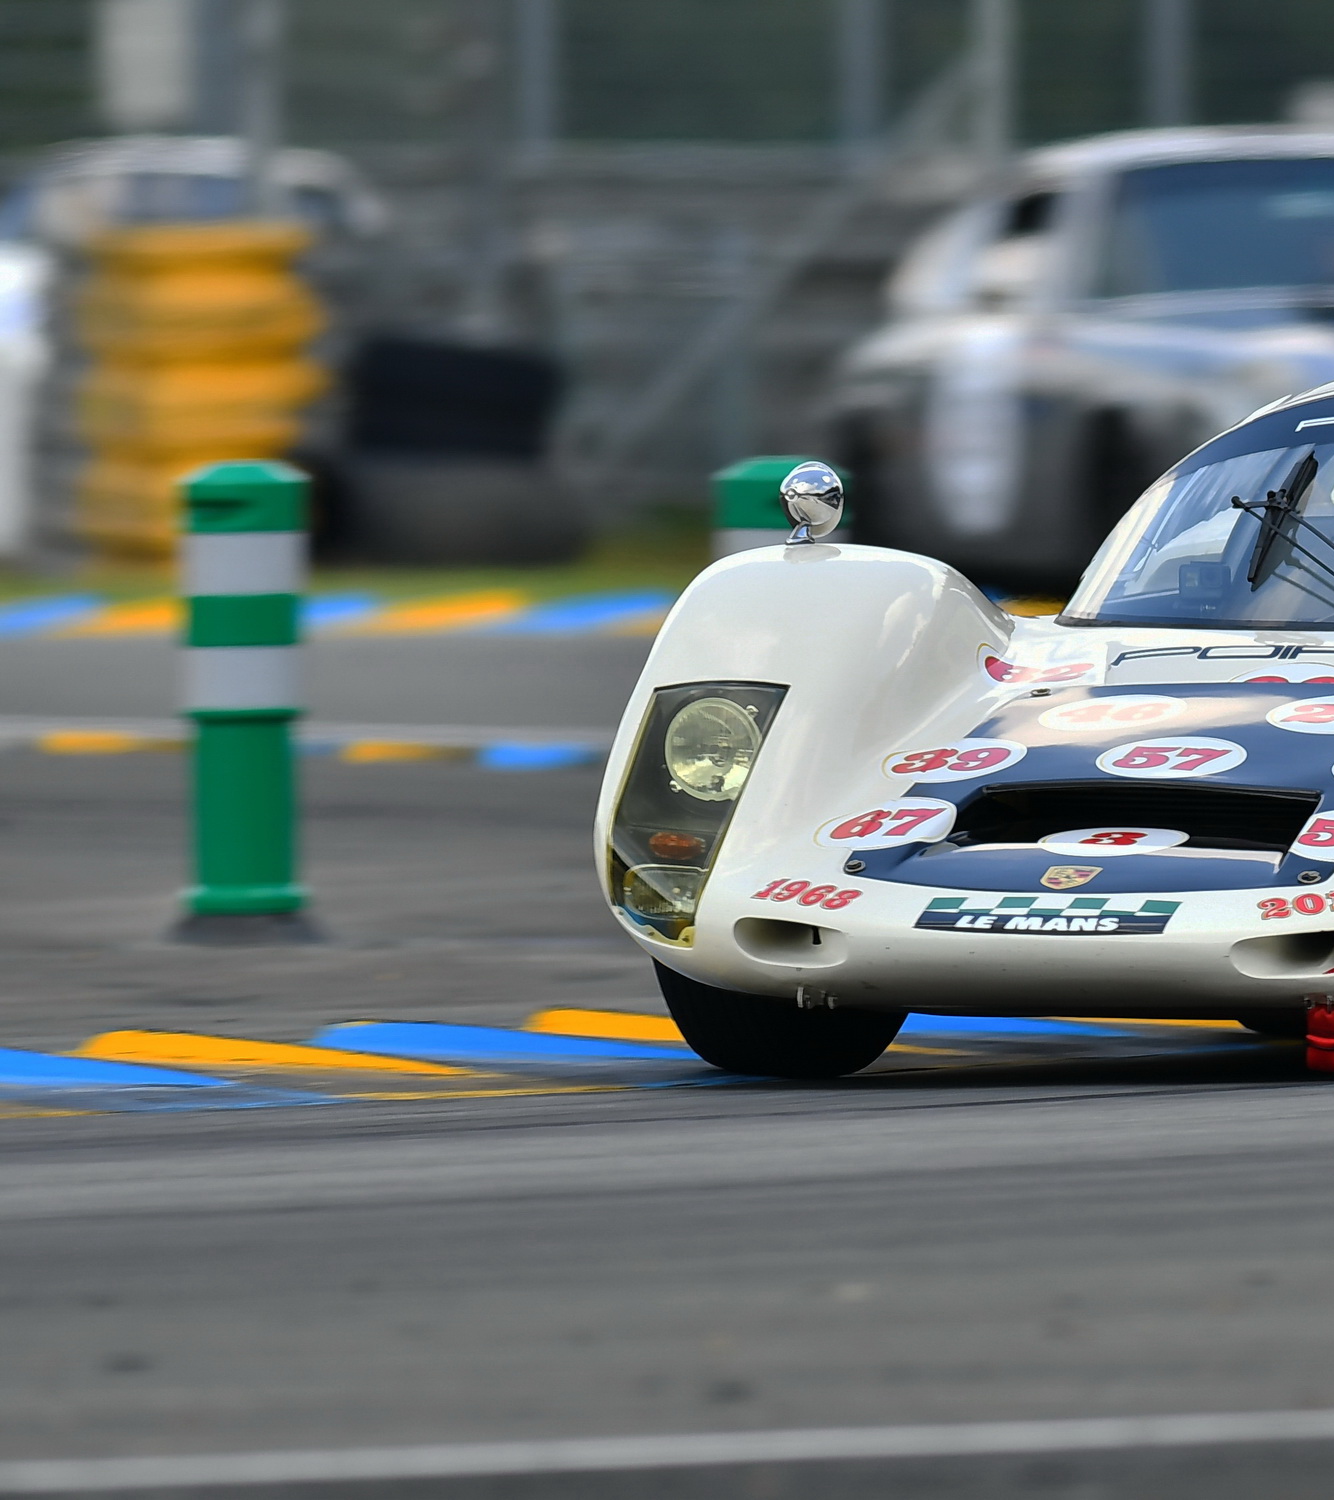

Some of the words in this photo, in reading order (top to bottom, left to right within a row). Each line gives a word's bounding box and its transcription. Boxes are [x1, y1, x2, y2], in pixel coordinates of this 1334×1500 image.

[890, 747, 1012, 775] 39
[1111, 746, 1233, 772] 57
[829, 808, 948, 840] 67
[1078, 831, 1149, 846] 3
[750, 878, 864, 910] 1968
[954, 915, 998, 930] LE
[1003, 917, 1120, 932] MANS
